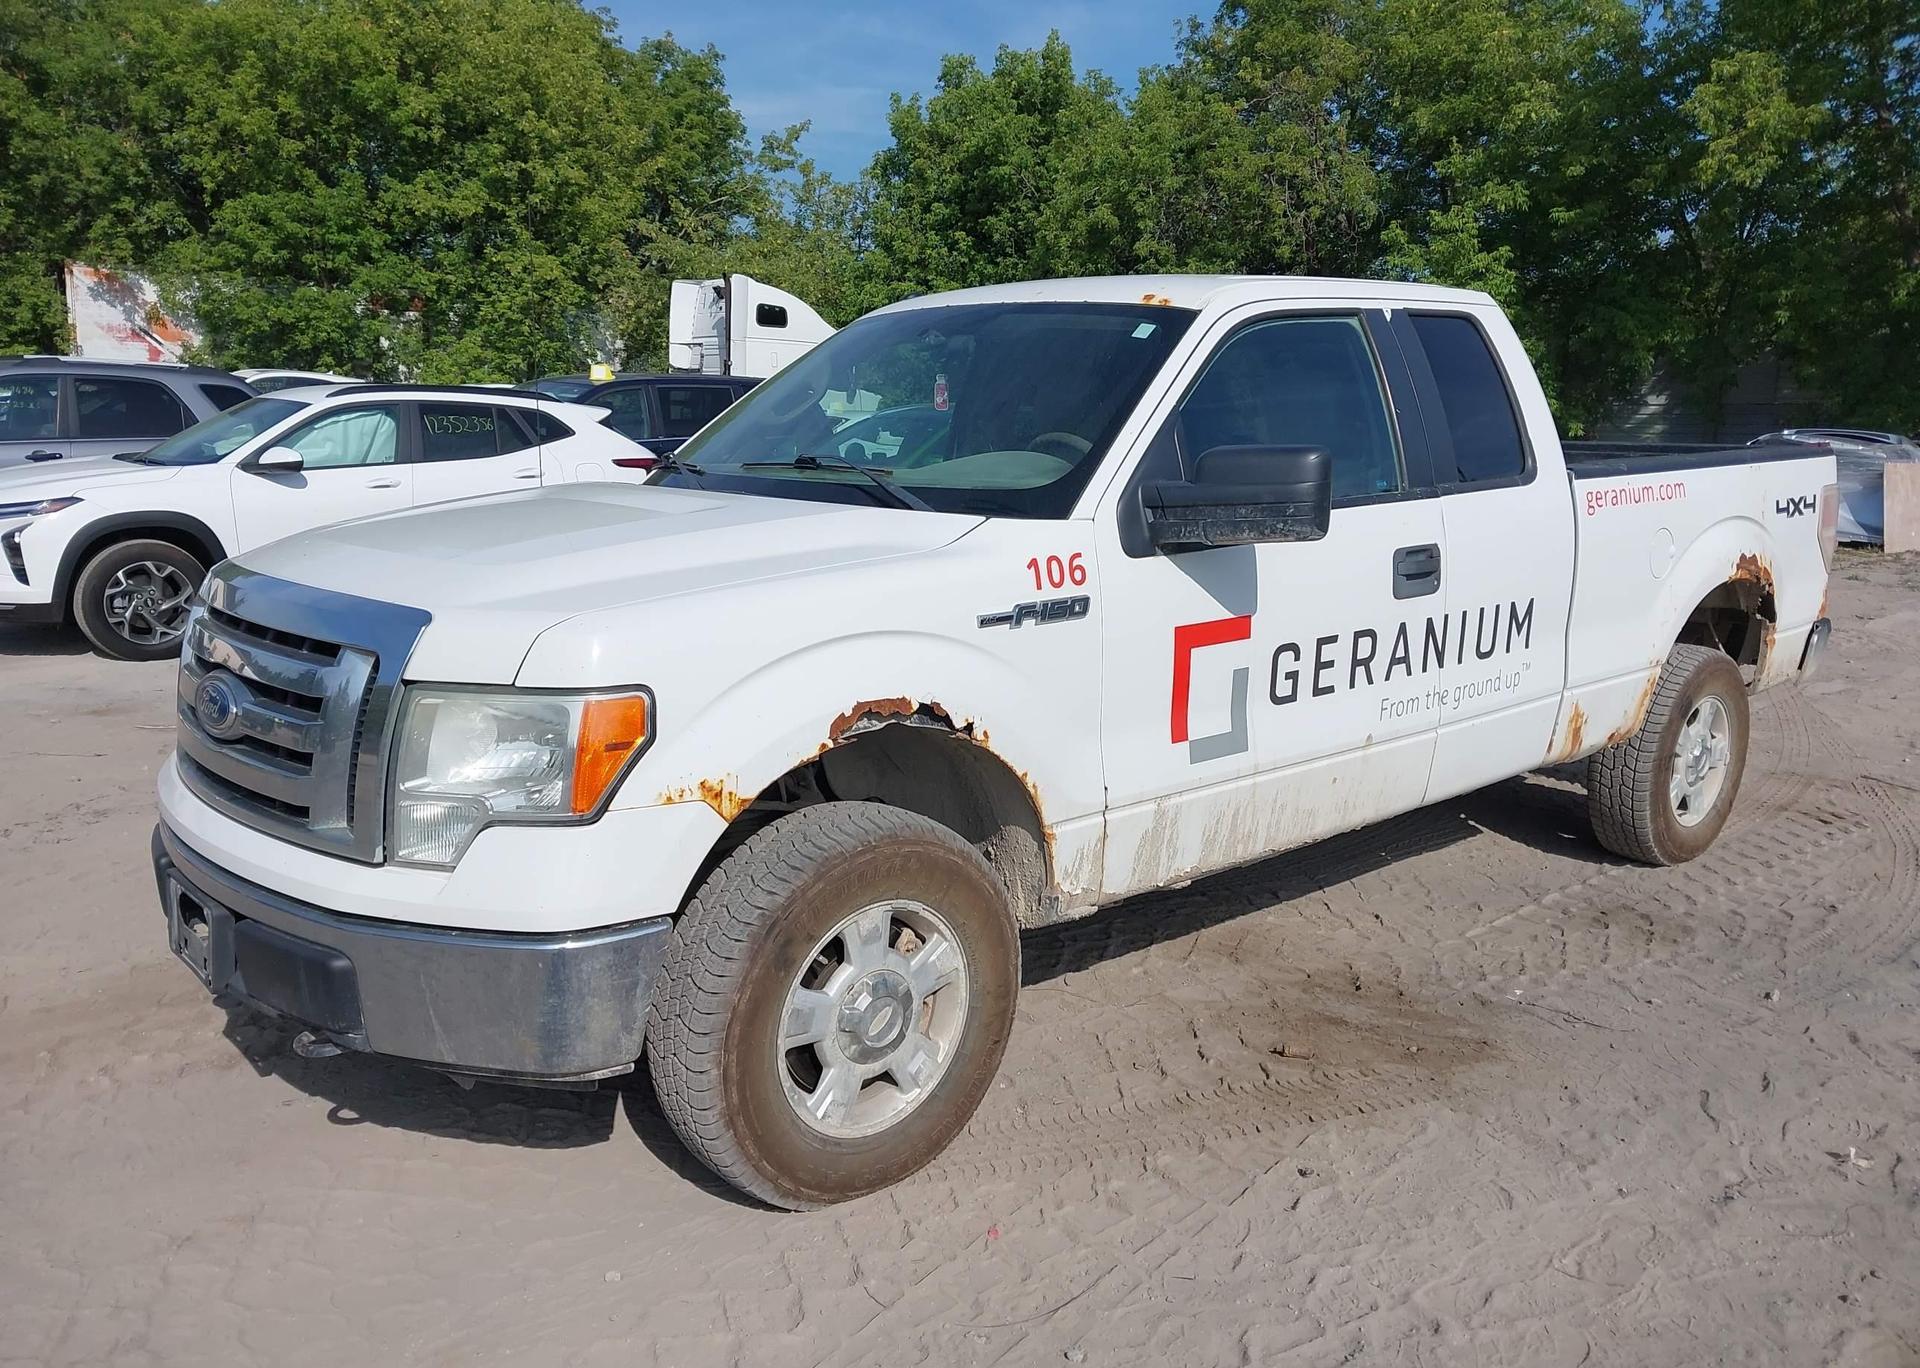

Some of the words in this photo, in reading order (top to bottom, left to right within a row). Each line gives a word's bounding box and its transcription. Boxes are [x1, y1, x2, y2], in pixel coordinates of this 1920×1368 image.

[423, 414, 494, 435] 12352356
[1586, 481, 1687, 516] geranium.com
[1026, 552, 1088, 591] 106
[1010, 594, 1090, 630] F-150
[1269, 598, 1535, 706] GERANIUM
[201, 687, 221, 719] Ford
[1379, 697, 1420, 722] From
[1425, 684, 1449, 711] the
[1453, 668, 1502, 710] ground
